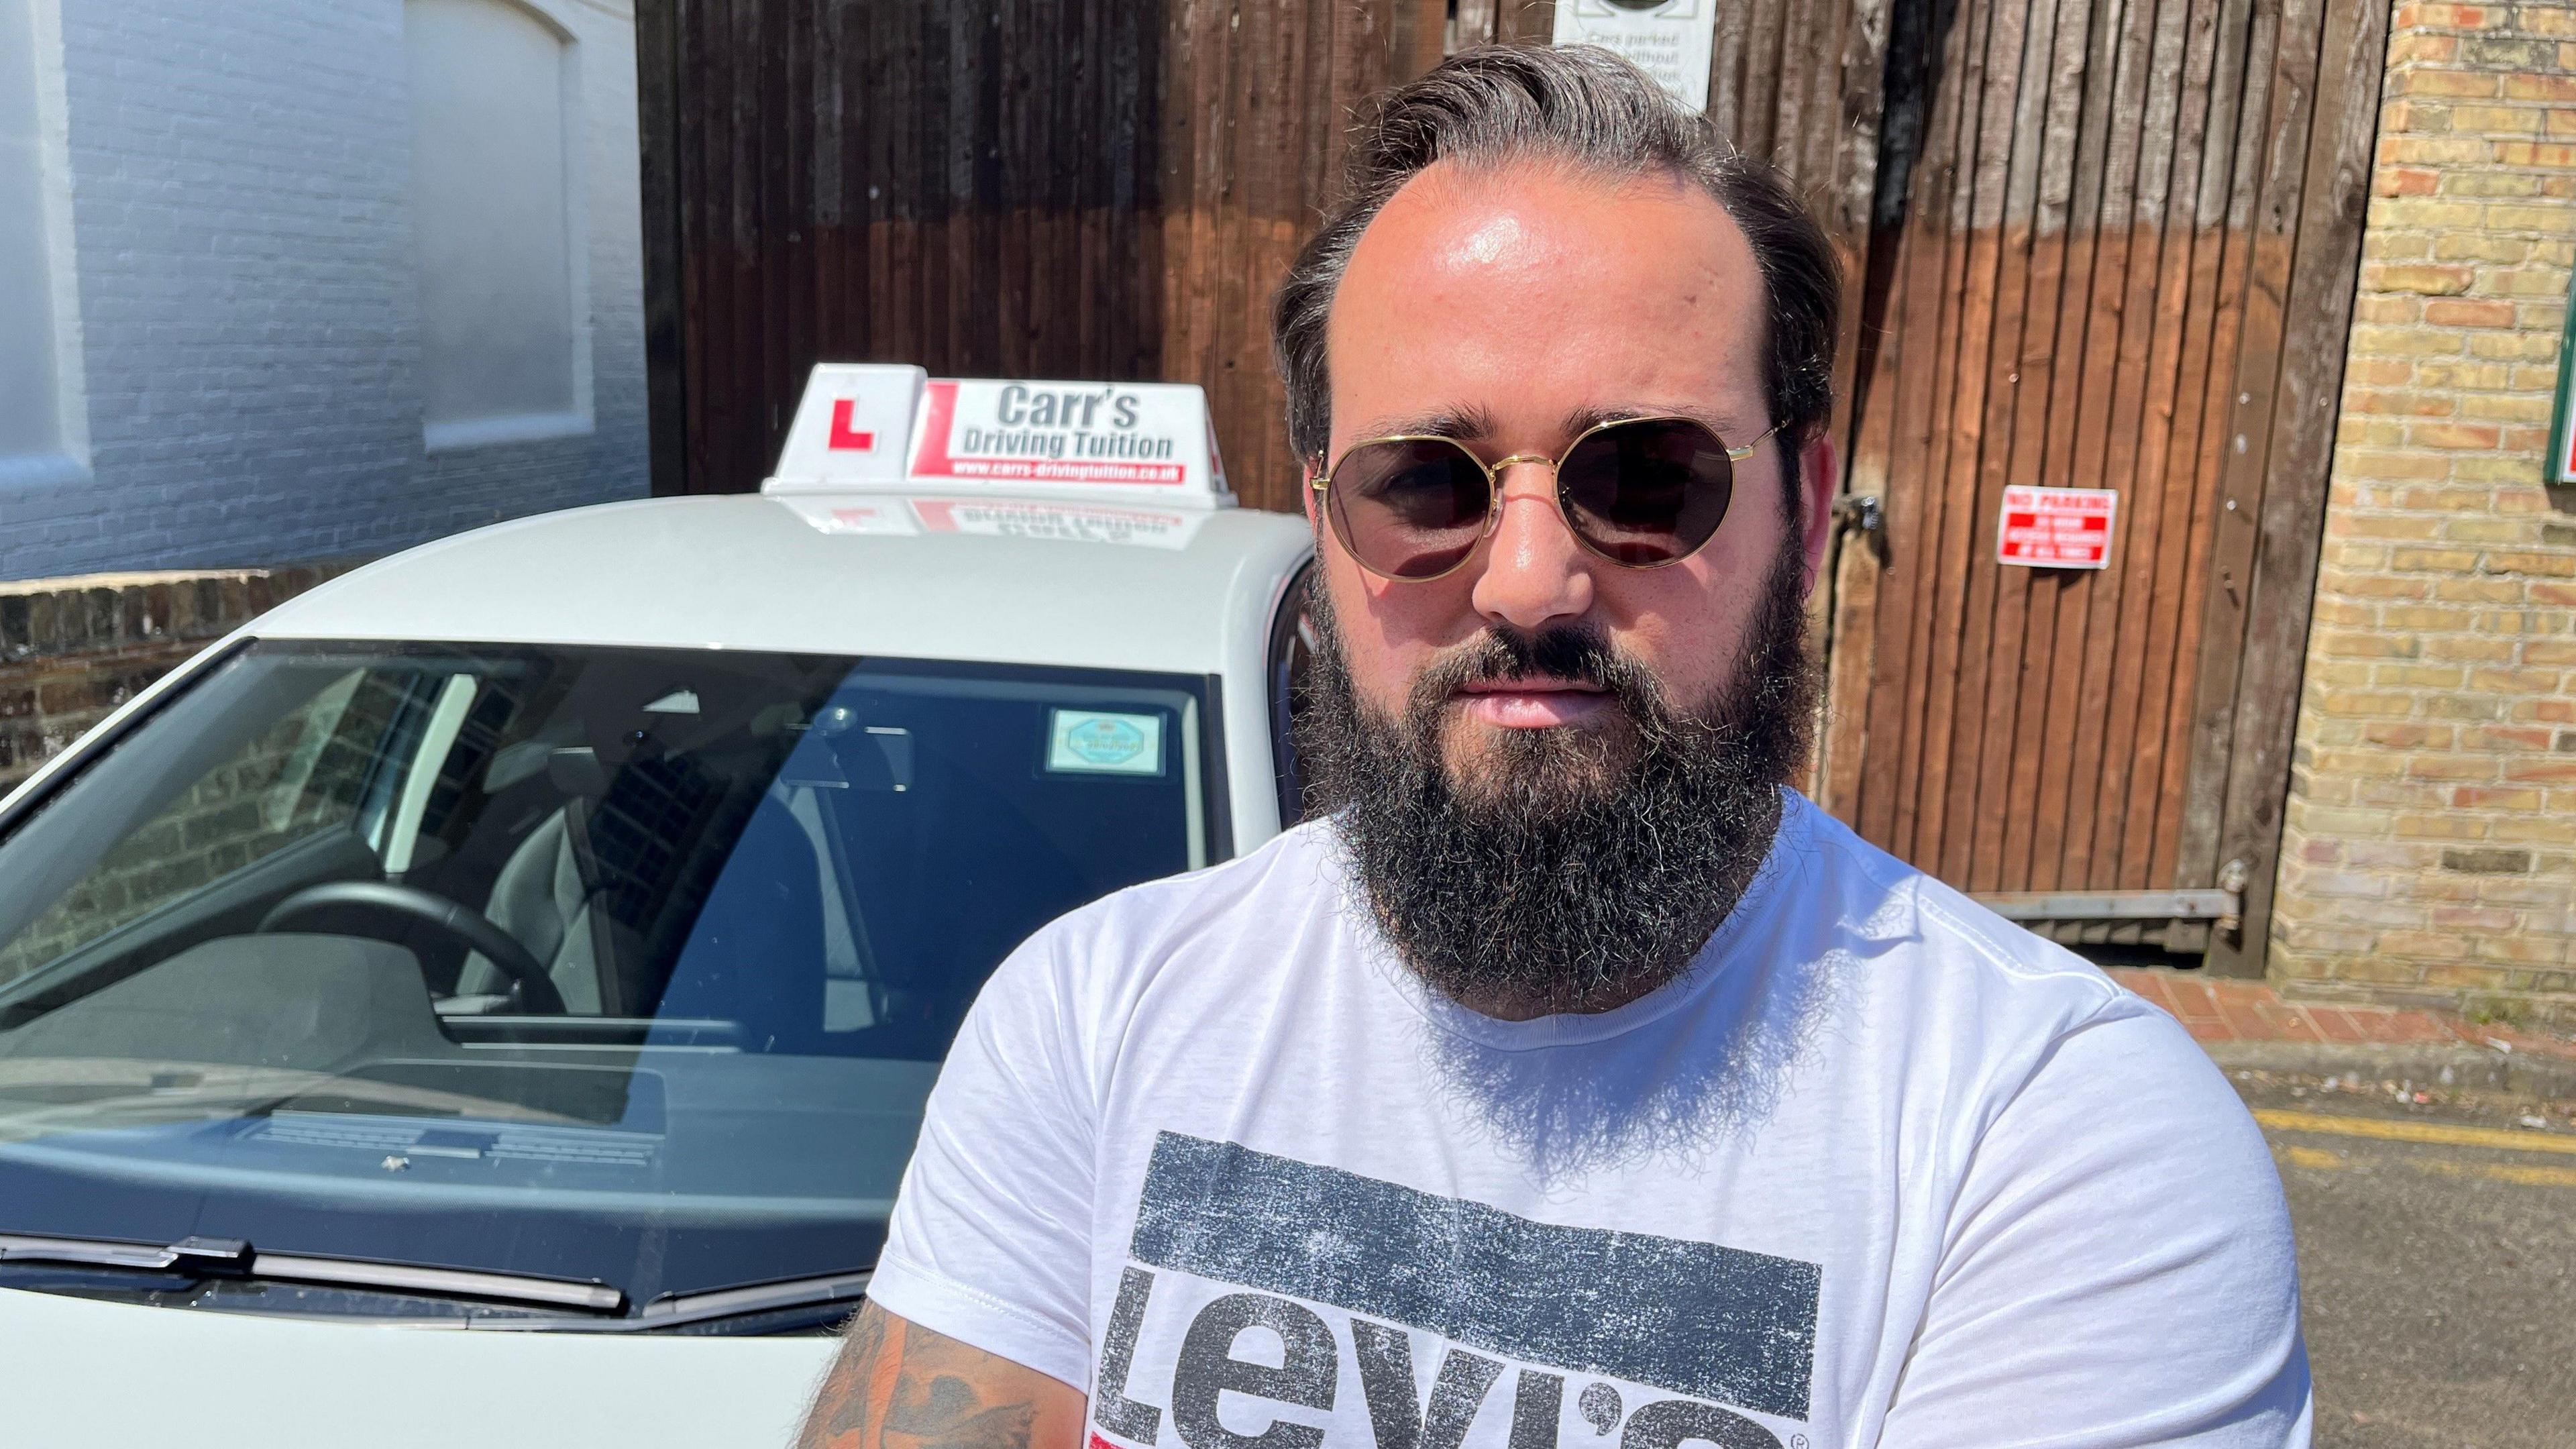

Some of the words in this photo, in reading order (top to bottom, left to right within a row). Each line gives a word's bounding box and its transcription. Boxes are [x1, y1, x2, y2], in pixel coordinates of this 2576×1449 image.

[998, 384, 1139, 428] Carr's
[828, 399, 874, 449] L
[963, 428, 1066, 458] Driving
[1075, 431, 1174, 458] Tuition
[953, 460, 1179, 482] www.carrs-drivingtuition.co.uk
[2006, 492, 2034, 504] NO
[2040, 494, 2111, 508] PARKING
